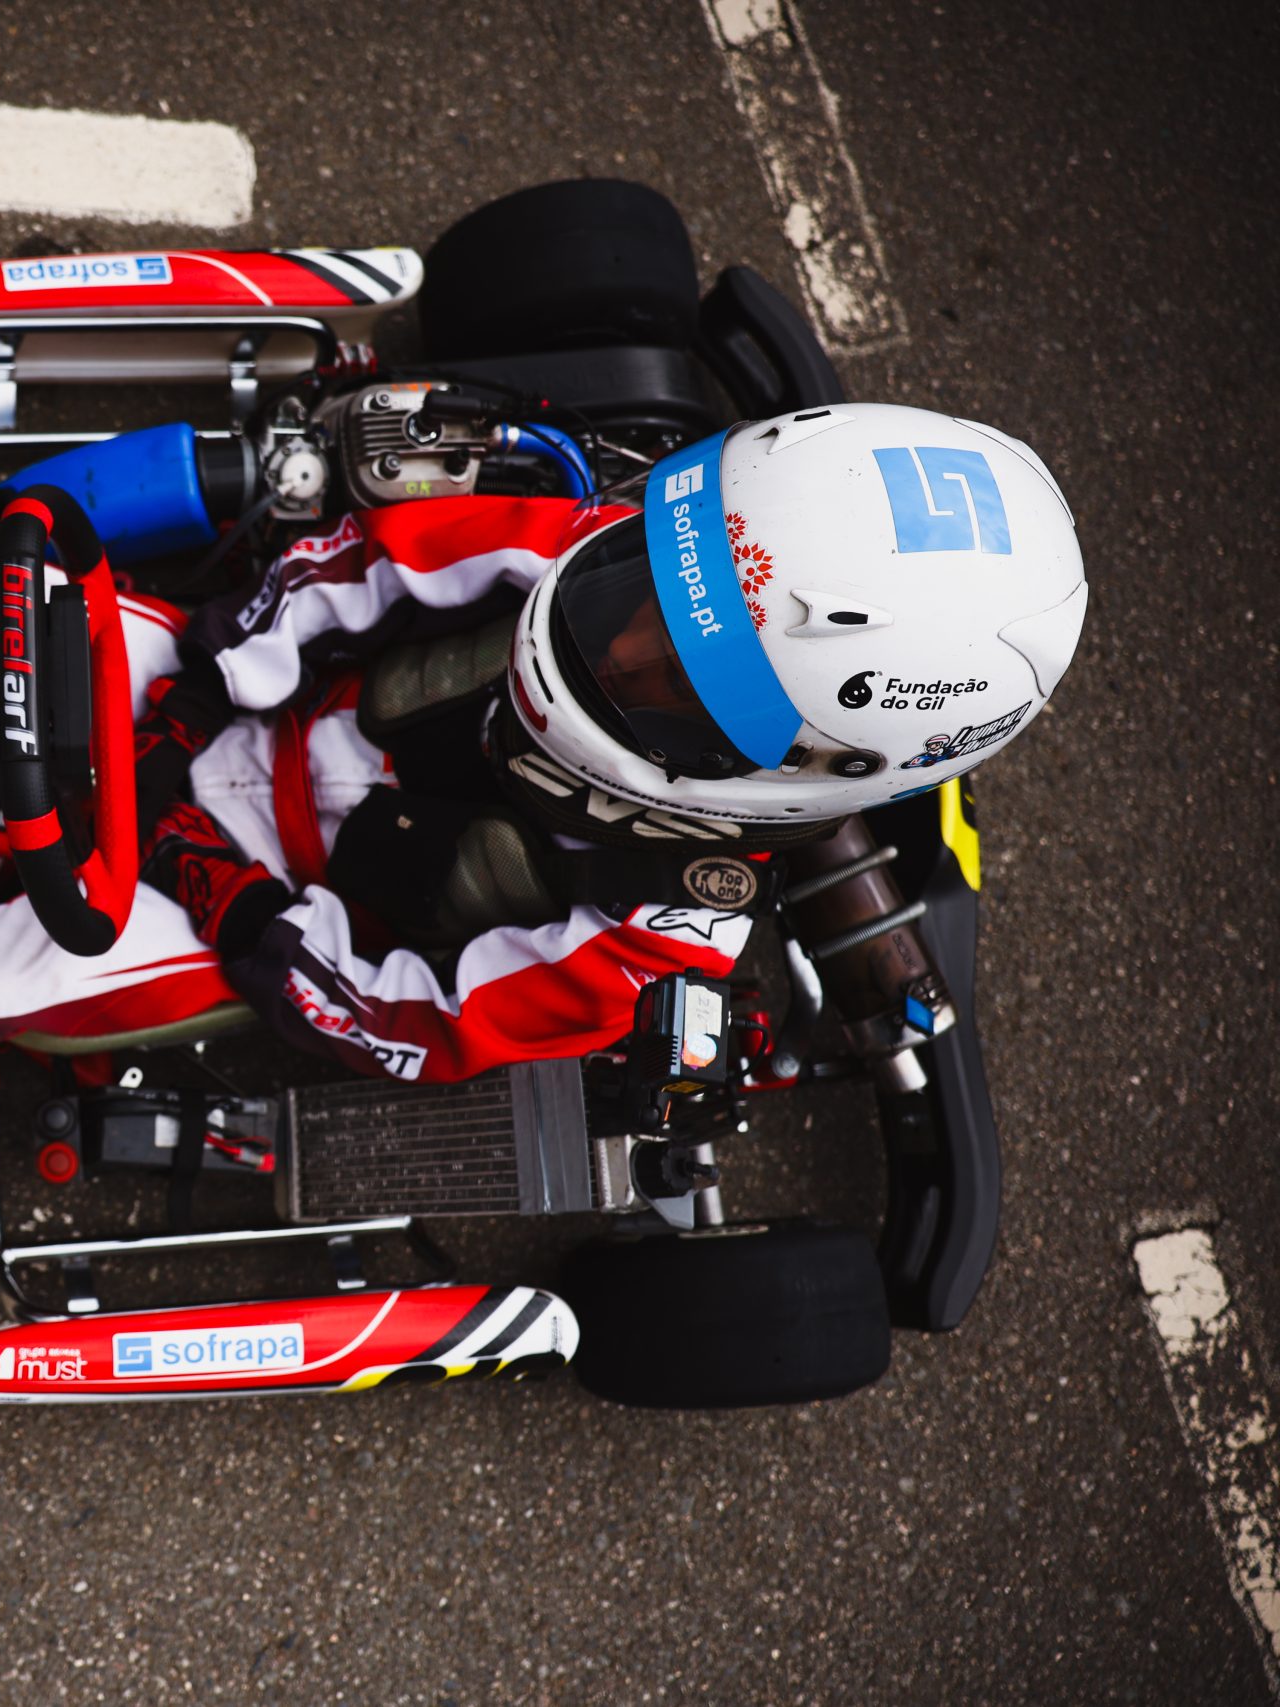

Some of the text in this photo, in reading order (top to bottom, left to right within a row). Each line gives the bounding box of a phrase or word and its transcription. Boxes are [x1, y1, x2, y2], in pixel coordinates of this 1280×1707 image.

[7, 258, 129, 284] sofrapa
[672, 502, 724, 637] sofrapa.pt
[2, 563, 40, 756] birelart
[885, 677, 988, 697] Fundação
[880, 695, 946, 711] do Gil
[719, 869, 744, 886] Top
[717, 885, 743, 898] one
[161, 1331, 300, 1367] sofrapa
[17, 1357, 89, 1380] must
